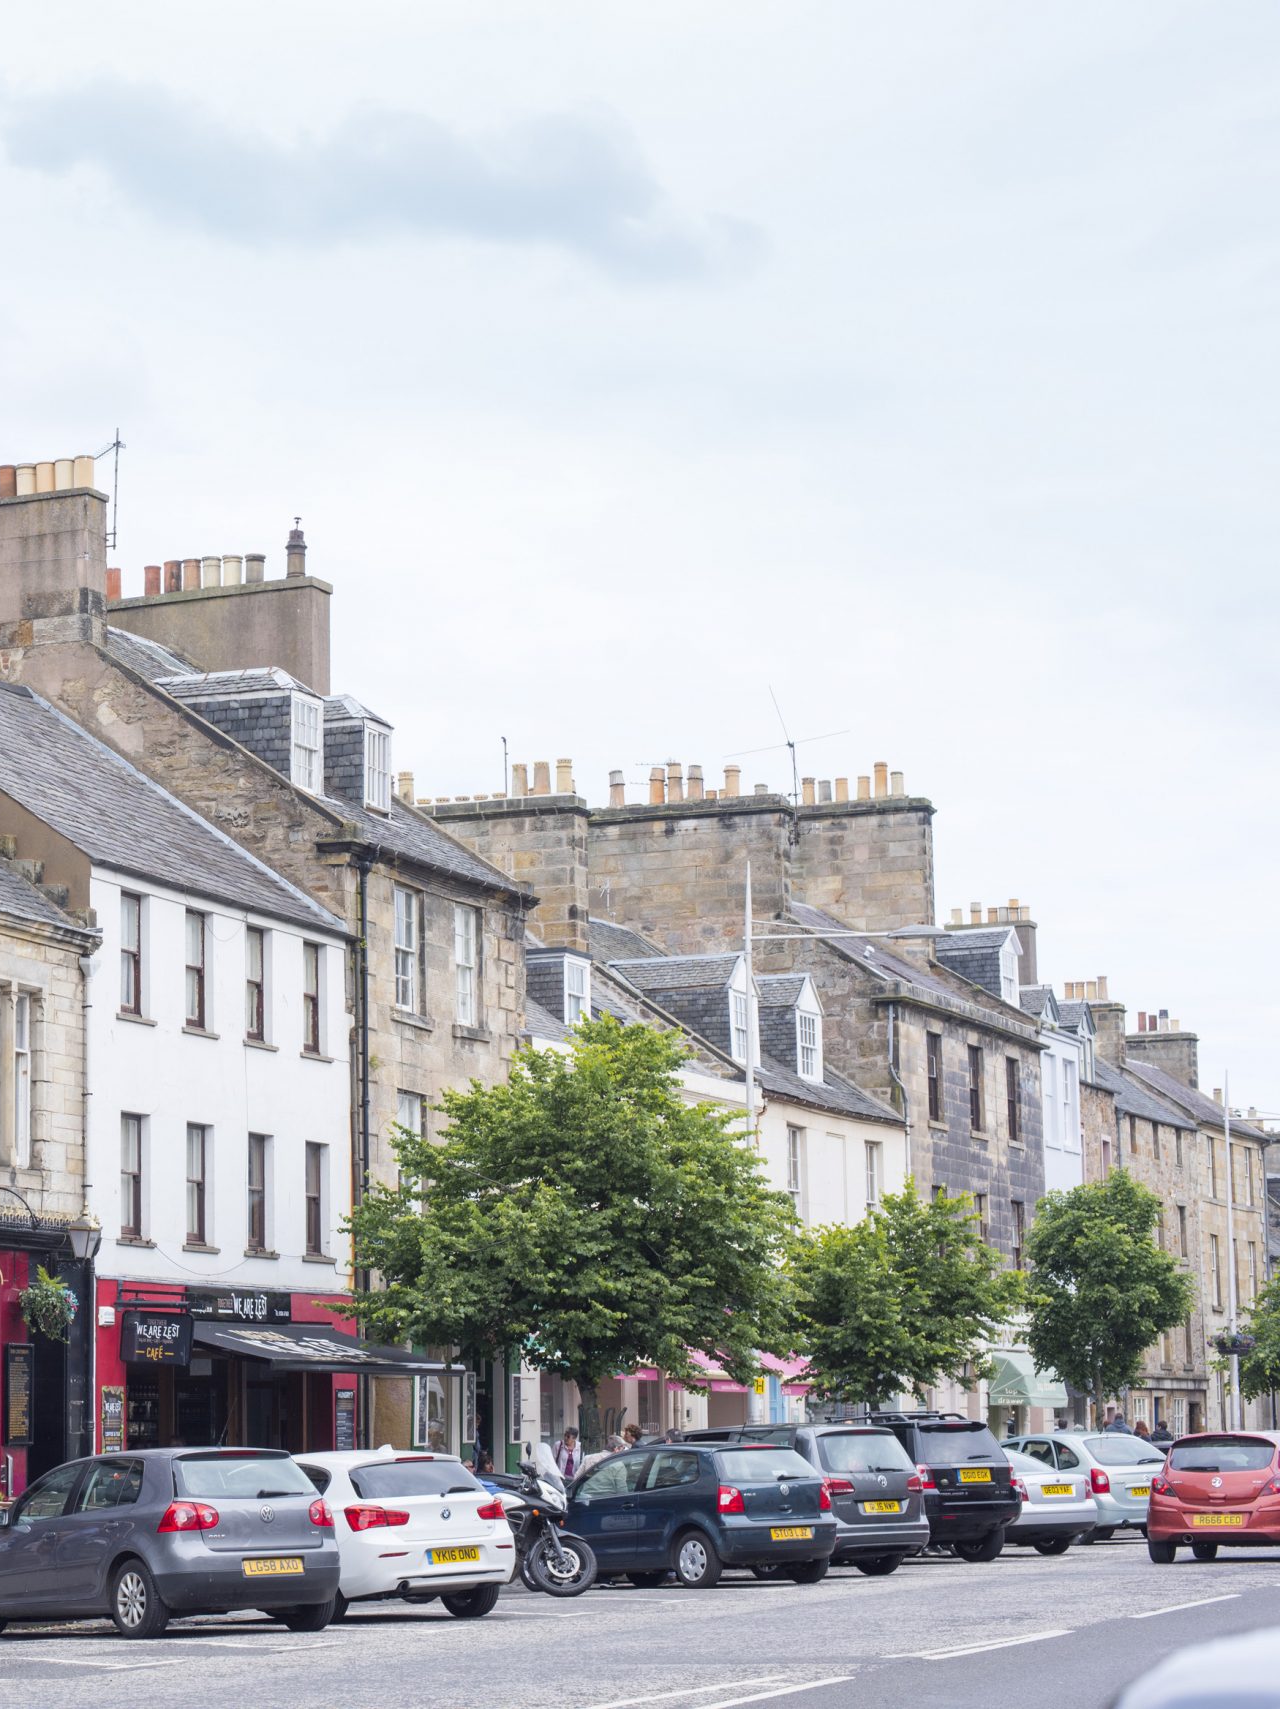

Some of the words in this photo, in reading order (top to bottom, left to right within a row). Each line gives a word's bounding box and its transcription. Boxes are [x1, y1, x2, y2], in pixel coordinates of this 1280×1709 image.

[231, 1292, 246, 1319] WE
[244, 1298, 254, 1319] ARE
[255, 1294, 267, 1319] ZEST
[134, 1321, 151, 1338] WE
[149, 1325, 161, 1339] ARE
[163, 1323, 180, 1339] ZEST
[146, 1345, 163, 1360] CAFÉ
[756, 1379, 764, 1392] H
[1199, 1516, 1221, 1524] R666
[436, 1550, 457, 1562] YK16
[250, 1560, 277, 1573] LG58
